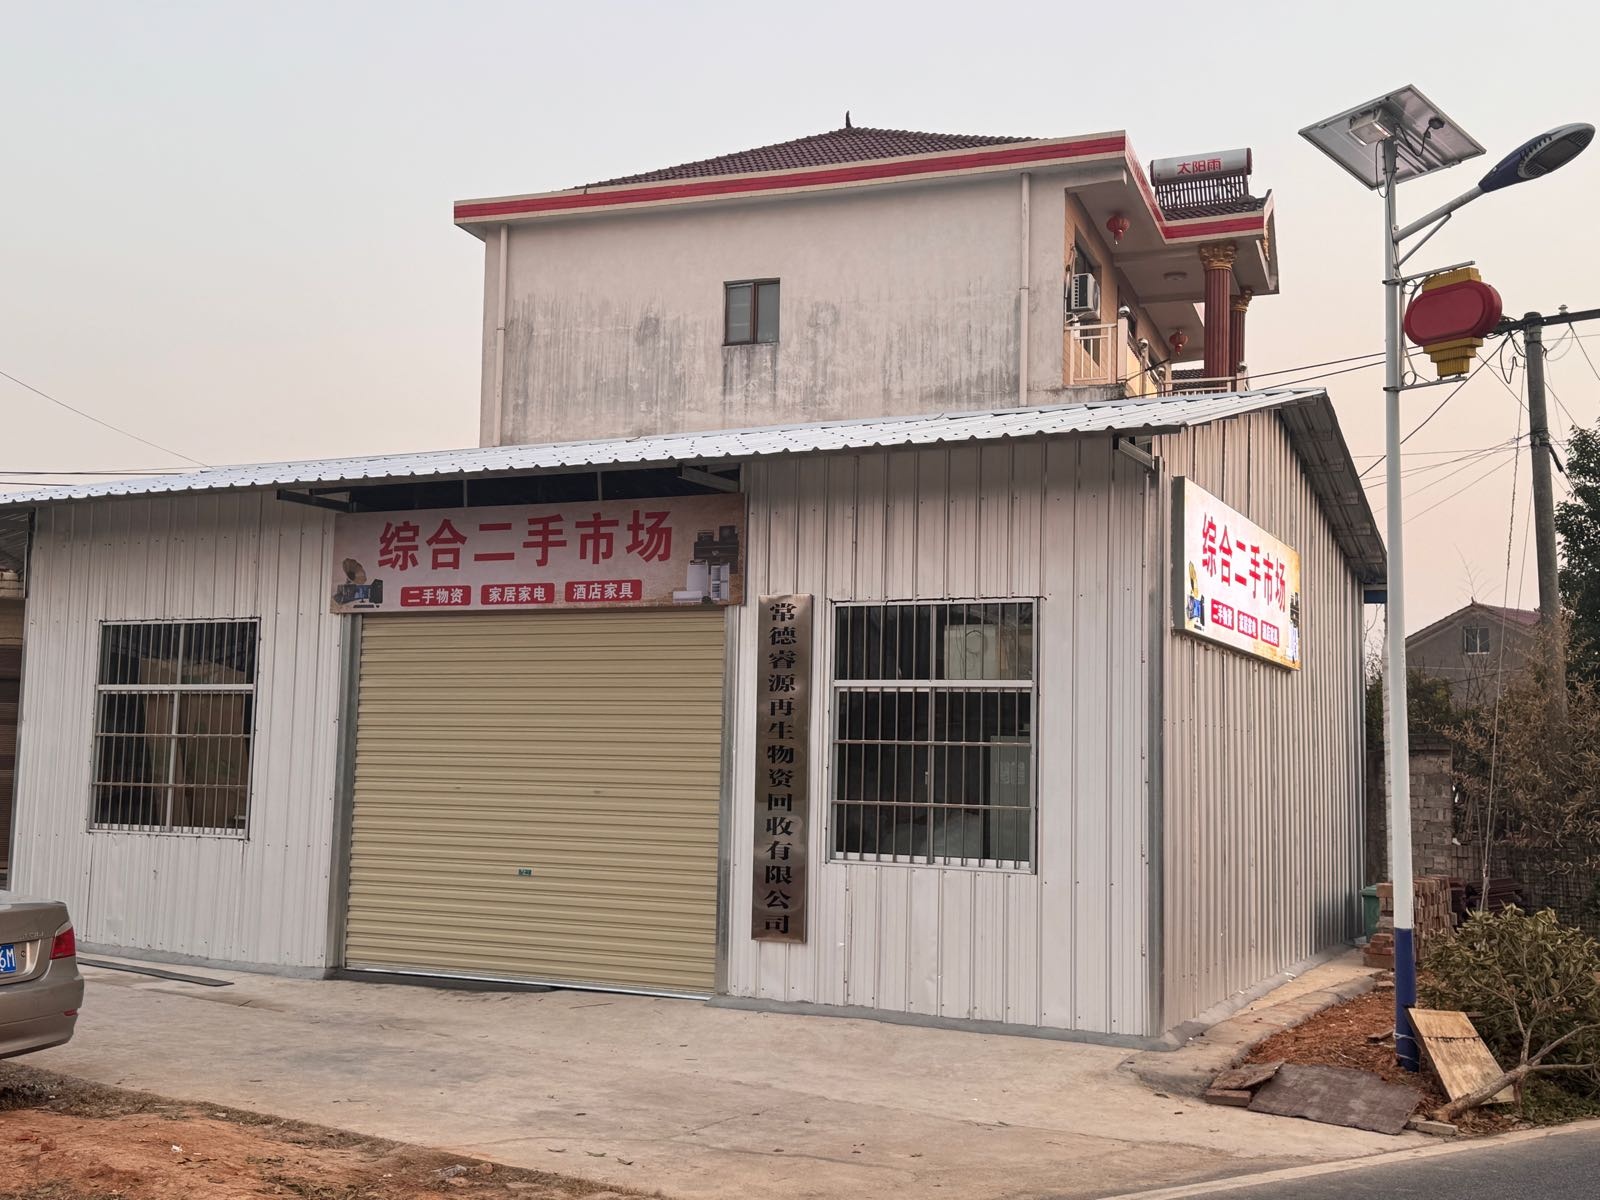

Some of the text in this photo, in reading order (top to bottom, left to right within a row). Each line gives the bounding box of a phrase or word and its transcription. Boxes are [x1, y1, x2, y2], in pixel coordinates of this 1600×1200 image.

[1177, 158, 1222, 175] 太阳雨
[378, 510, 672, 571] 综合二手市场
[1202, 512, 1285, 613] 综合二手市场
[407, 585, 463, 605] 二手物资
[488, 585, 546, 603] 家居家电
[573, 582, 633, 600] 酒店家具
[764, 603, 797, 934] 常德睿源再生物资回收有限公司
